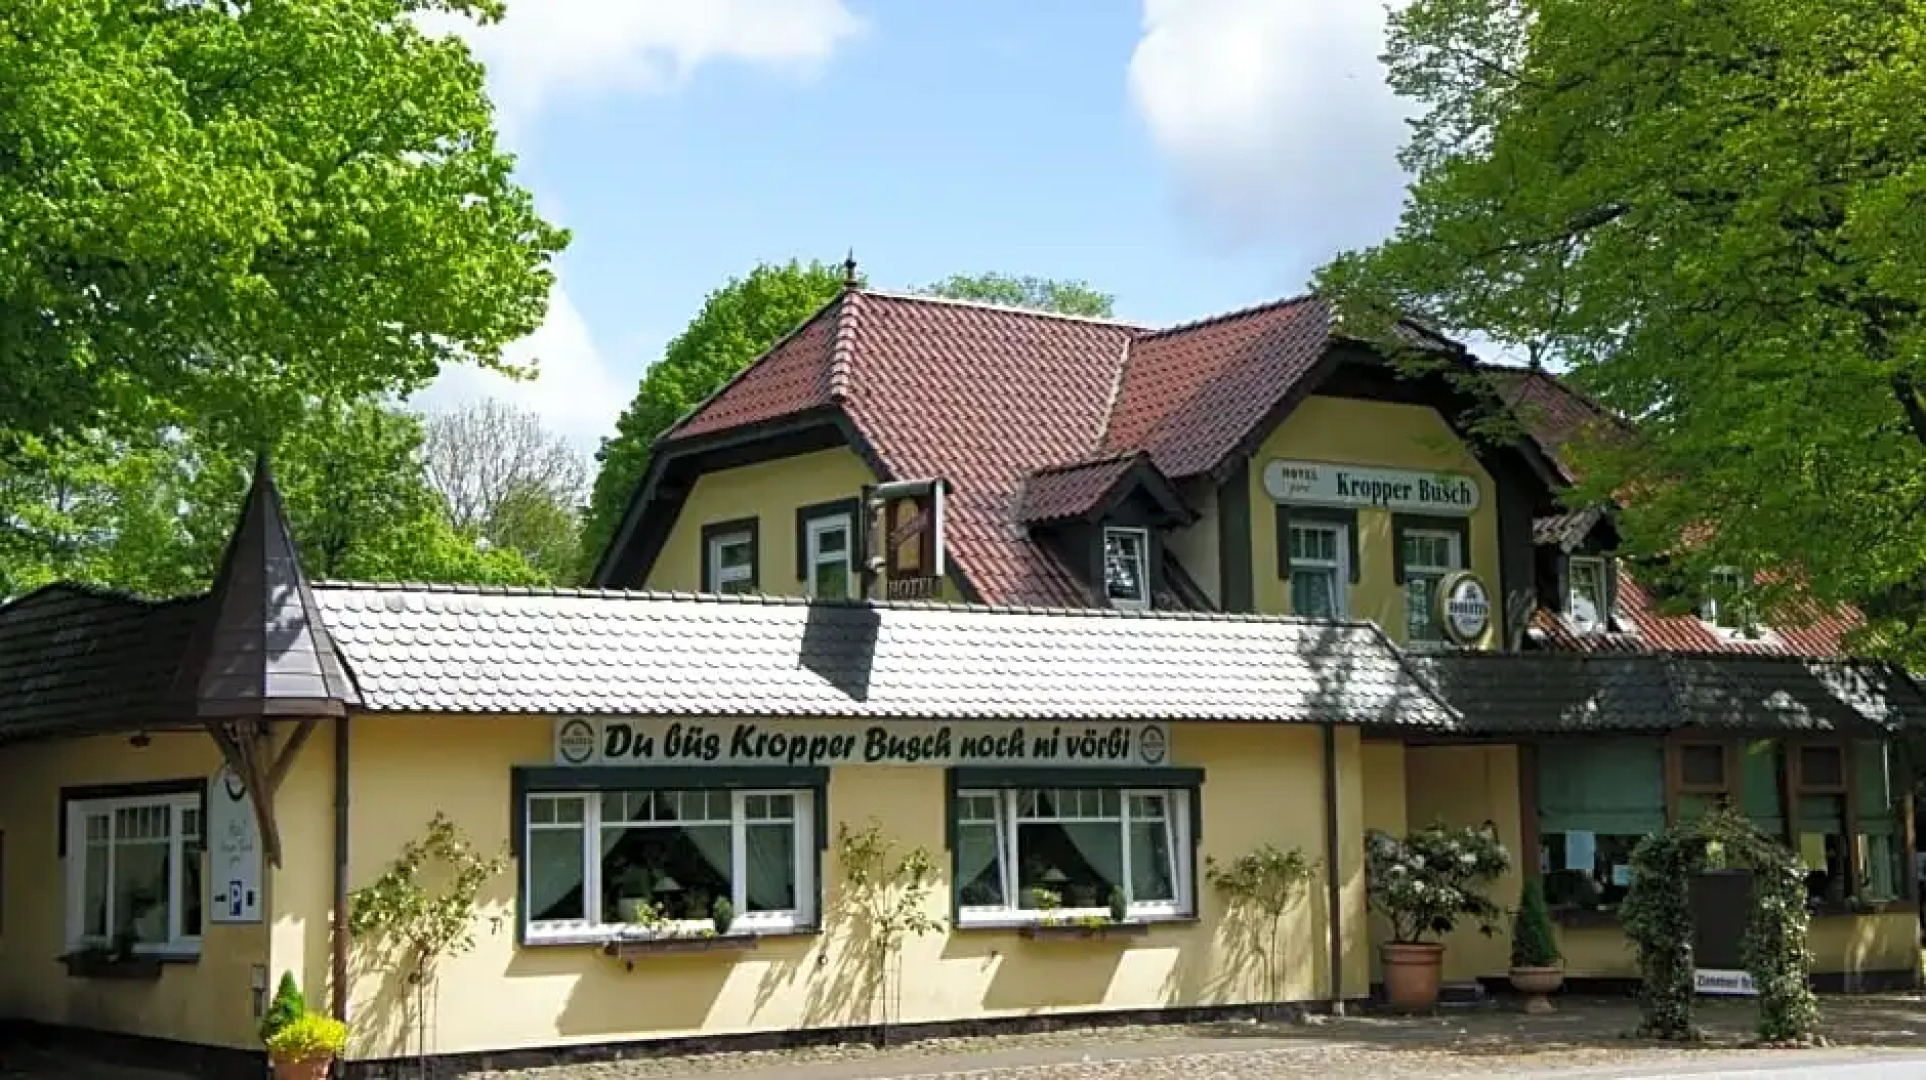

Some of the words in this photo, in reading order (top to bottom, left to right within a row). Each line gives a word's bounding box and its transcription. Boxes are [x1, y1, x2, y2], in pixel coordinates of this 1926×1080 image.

[1336, 473, 1412, 507] Kropper
[1418, 479, 1471, 504] Busch
[604, 723, 654, 757] Du
[729, 724, 855, 764] Kropper
[864, 726, 951, 762] Busch
[959, 727, 1026, 758] noch
[1032, 727, 1060, 758] ni
[1066, 728, 1131, 758] vörbi
